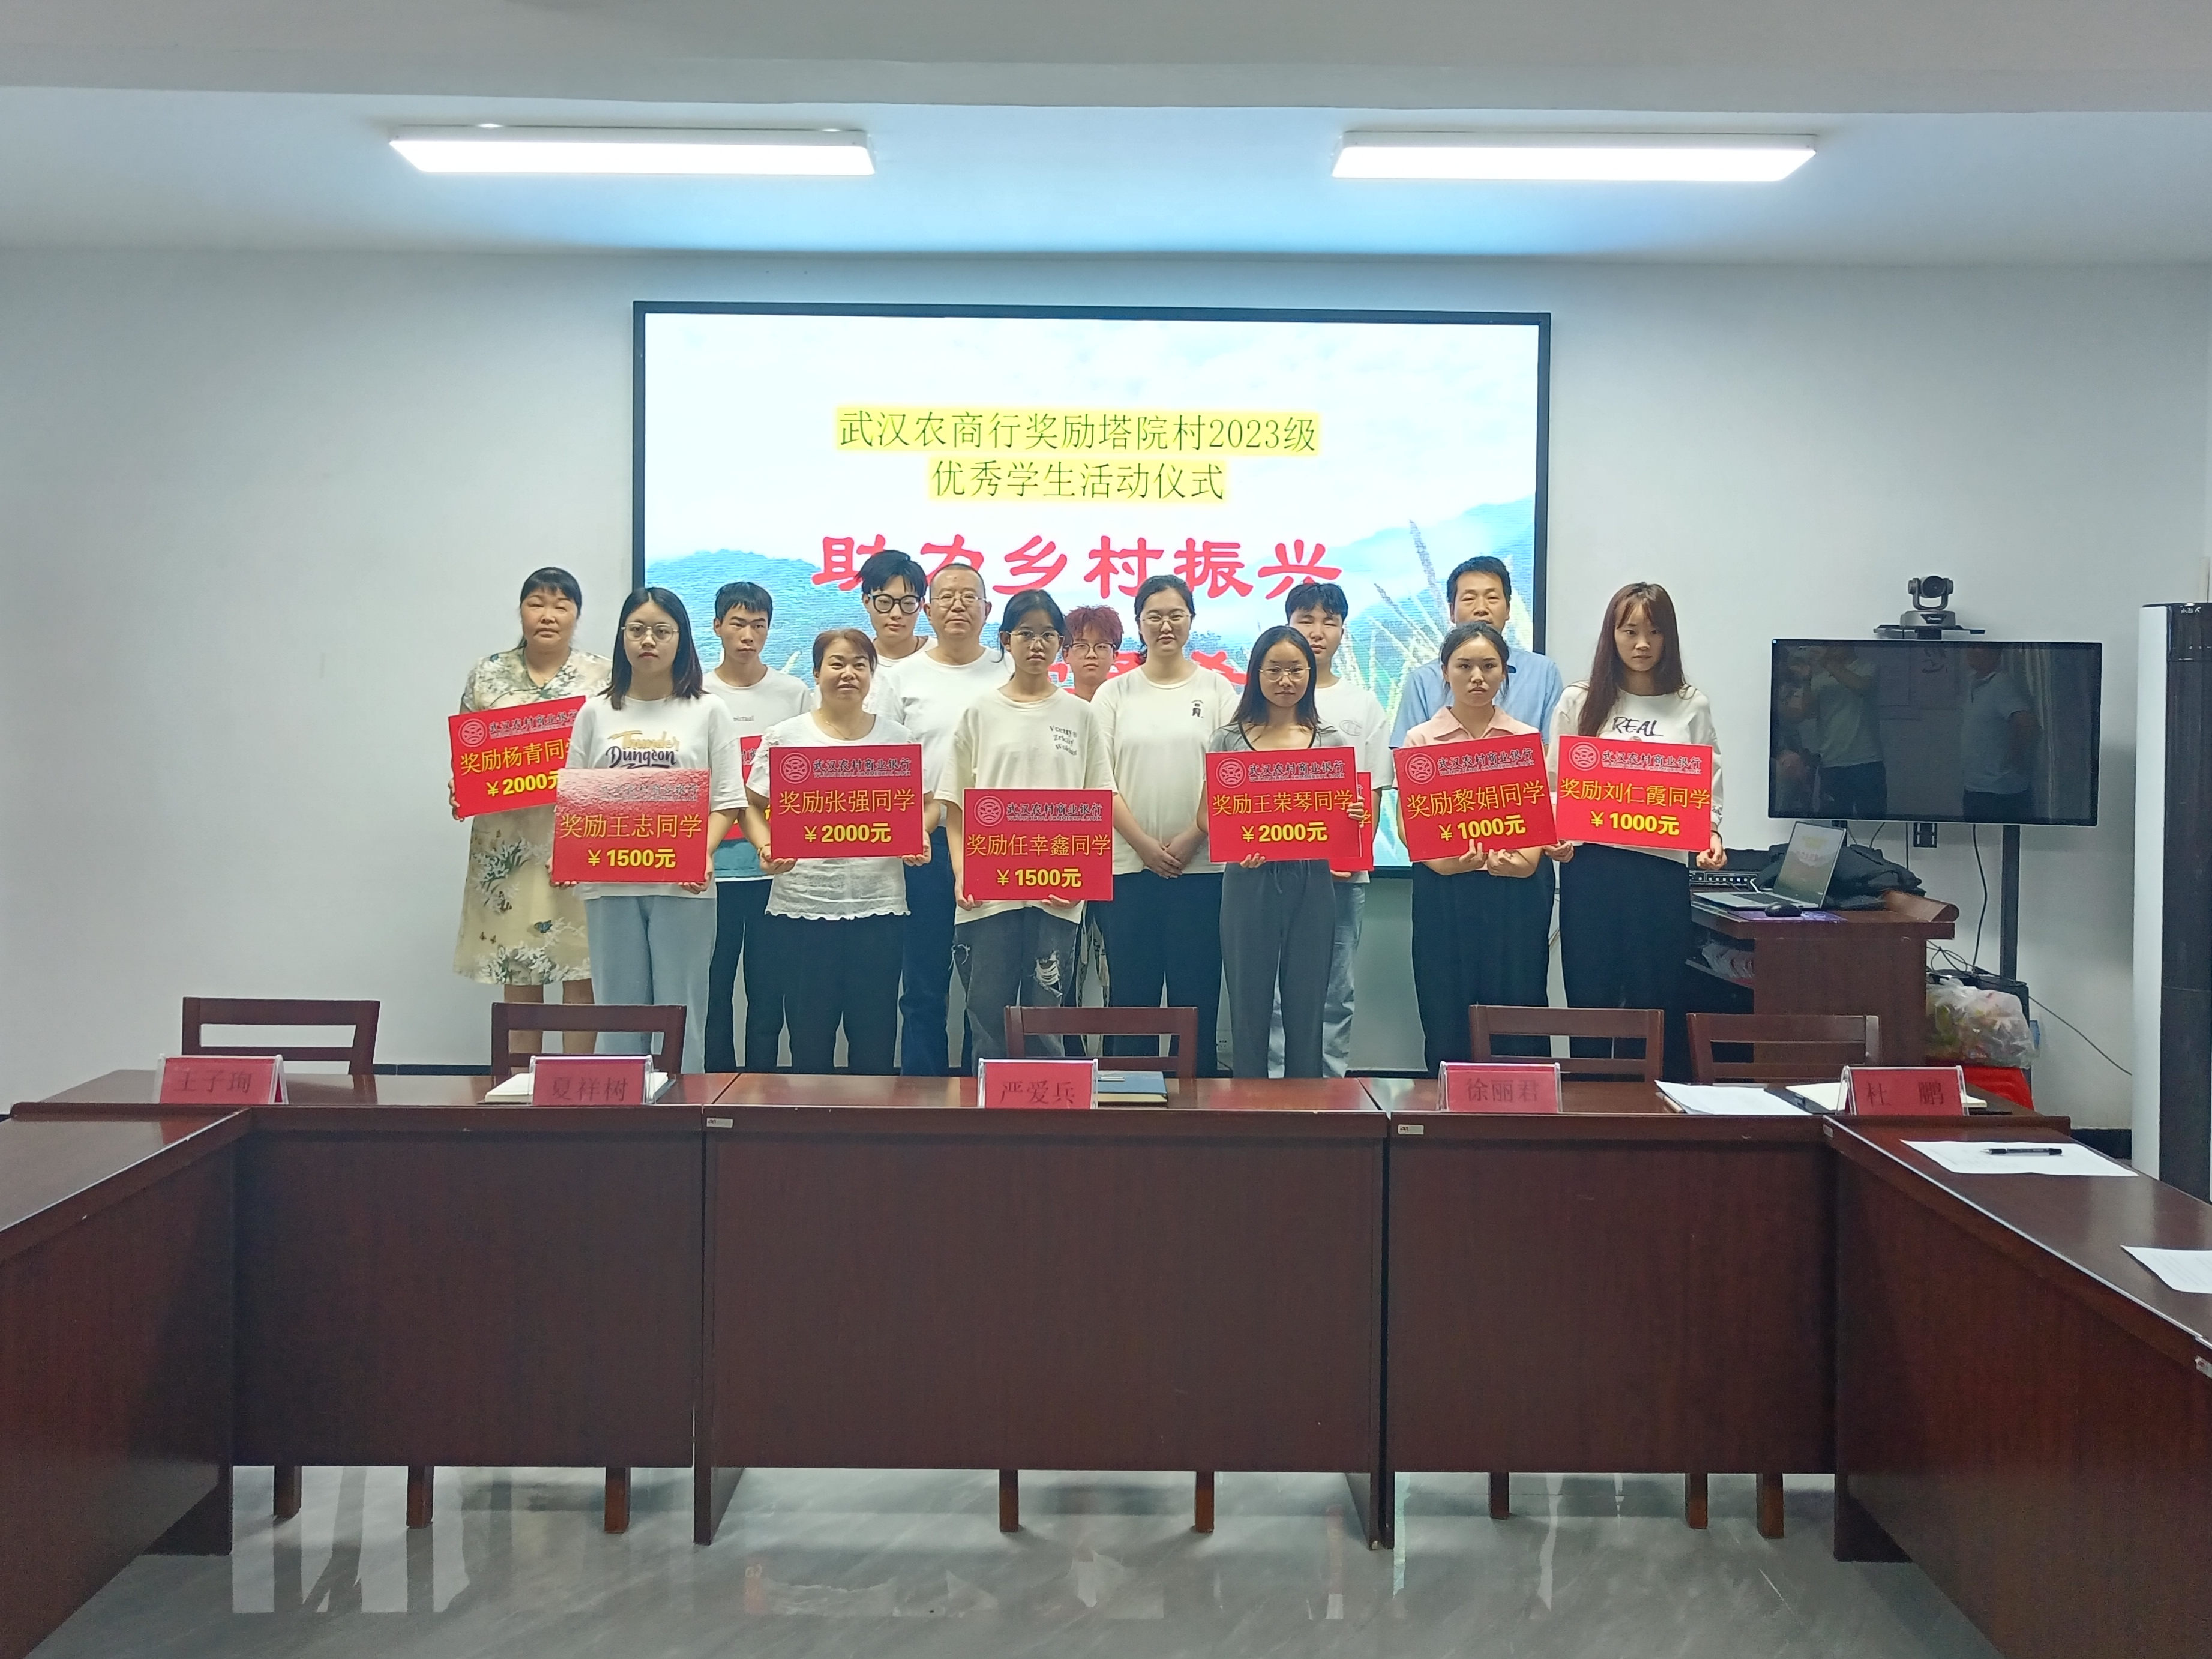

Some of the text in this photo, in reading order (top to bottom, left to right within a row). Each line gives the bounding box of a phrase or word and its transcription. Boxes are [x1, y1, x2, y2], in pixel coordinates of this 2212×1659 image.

[840, 409, 1316, 453] 武汉农商行奖励塔院村2023级
[932, 460, 1225, 501] 优秀学生活动仪式
[1612, 717, 1664, 736] REAL
[460, 738, 573, 776] 奖励杨青同
[605, 746, 676, 769] Dungeon
[813, 757, 911, 772] 武汉农村商业银行
[1248, 760, 1345, 777] 武汉农村商业银行
[1437, 748, 1534, 771] 武汉农村商业银行
[1602, 750, 1702, 769] 武汉农村商业银行
[778, 788, 915, 815] 奖励张强同学
[1212, 789, 1353, 816] 奖励王荣琴同学
[1407, 780, 1545, 820] 奖励黎娟同学
[1560, 778, 1710, 809] 奖励刘仁霞同学
[1006, 802, 1103, 816] 武汉农村商业银行
[559, 813, 702, 839] 奖励王志同学
[966, 834, 1110, 857] 奖励任幸鑫同学
[552, 1077, 629, 1102] 夏祥树
[1000, 1080, 1075, 1104] 严爱兵
